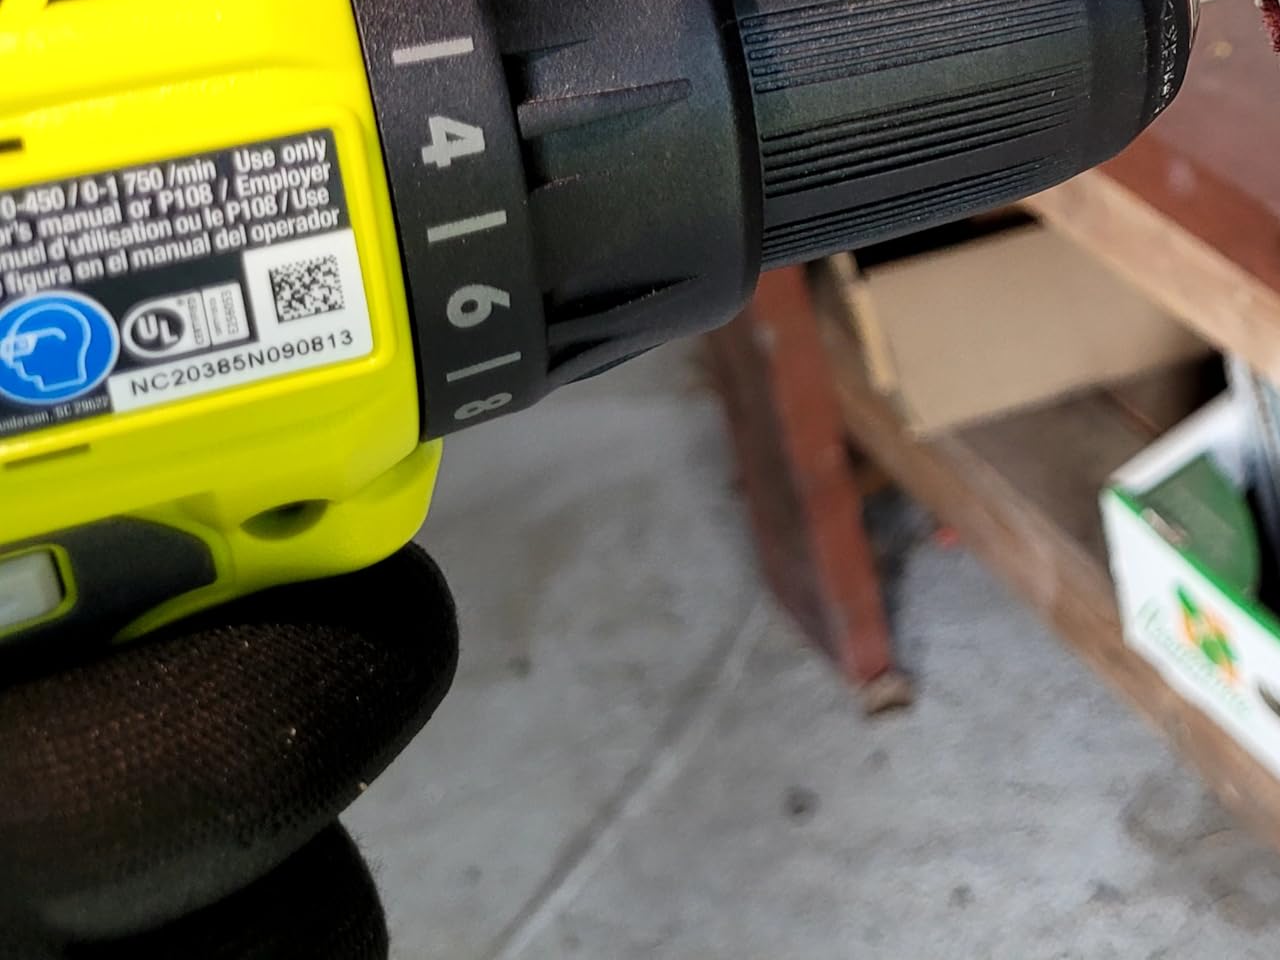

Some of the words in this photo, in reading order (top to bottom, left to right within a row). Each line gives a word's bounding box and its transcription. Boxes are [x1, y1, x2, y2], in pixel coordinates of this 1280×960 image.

[422, 116, 486, 168] 4
[0, 185, 66, 220] 0-450
[81, 174, 118, 205] 0-1
[123, 166, 164, 196] 750
[168, 158, 217, 188] /min
[234, 148, 276, 173] Use
[282, 136, 327, 163] only
[37, 200, 123, 238] manual
[128, 197, 152, 220] or
[157, 182, 214, 214] P108
[235, 162, 331, 198] Employer
[4, 263, 73, 296] figura
[75, 258, 105, 281] en
[106, 247, 129, 274] el
[132, 231, 212, 269] manual
[214, 223, 247, 251] del
[250, 208, 340, 244] operador
[48, 219, 173, 262] d'utilisation
[175, 213, 203, 235] ou
[204, 205, 225, 230] le
[225, 195, 279, 225] P108
[291, 186, 330, 210] Use
[137, 313, 179, 345] UL
[446, 283, 511, 330] 6
[131, 330, 354, 396] NC20385N090813
[0, 410, 54, 433] nderson,
[454, 392, 513, 420] 8
